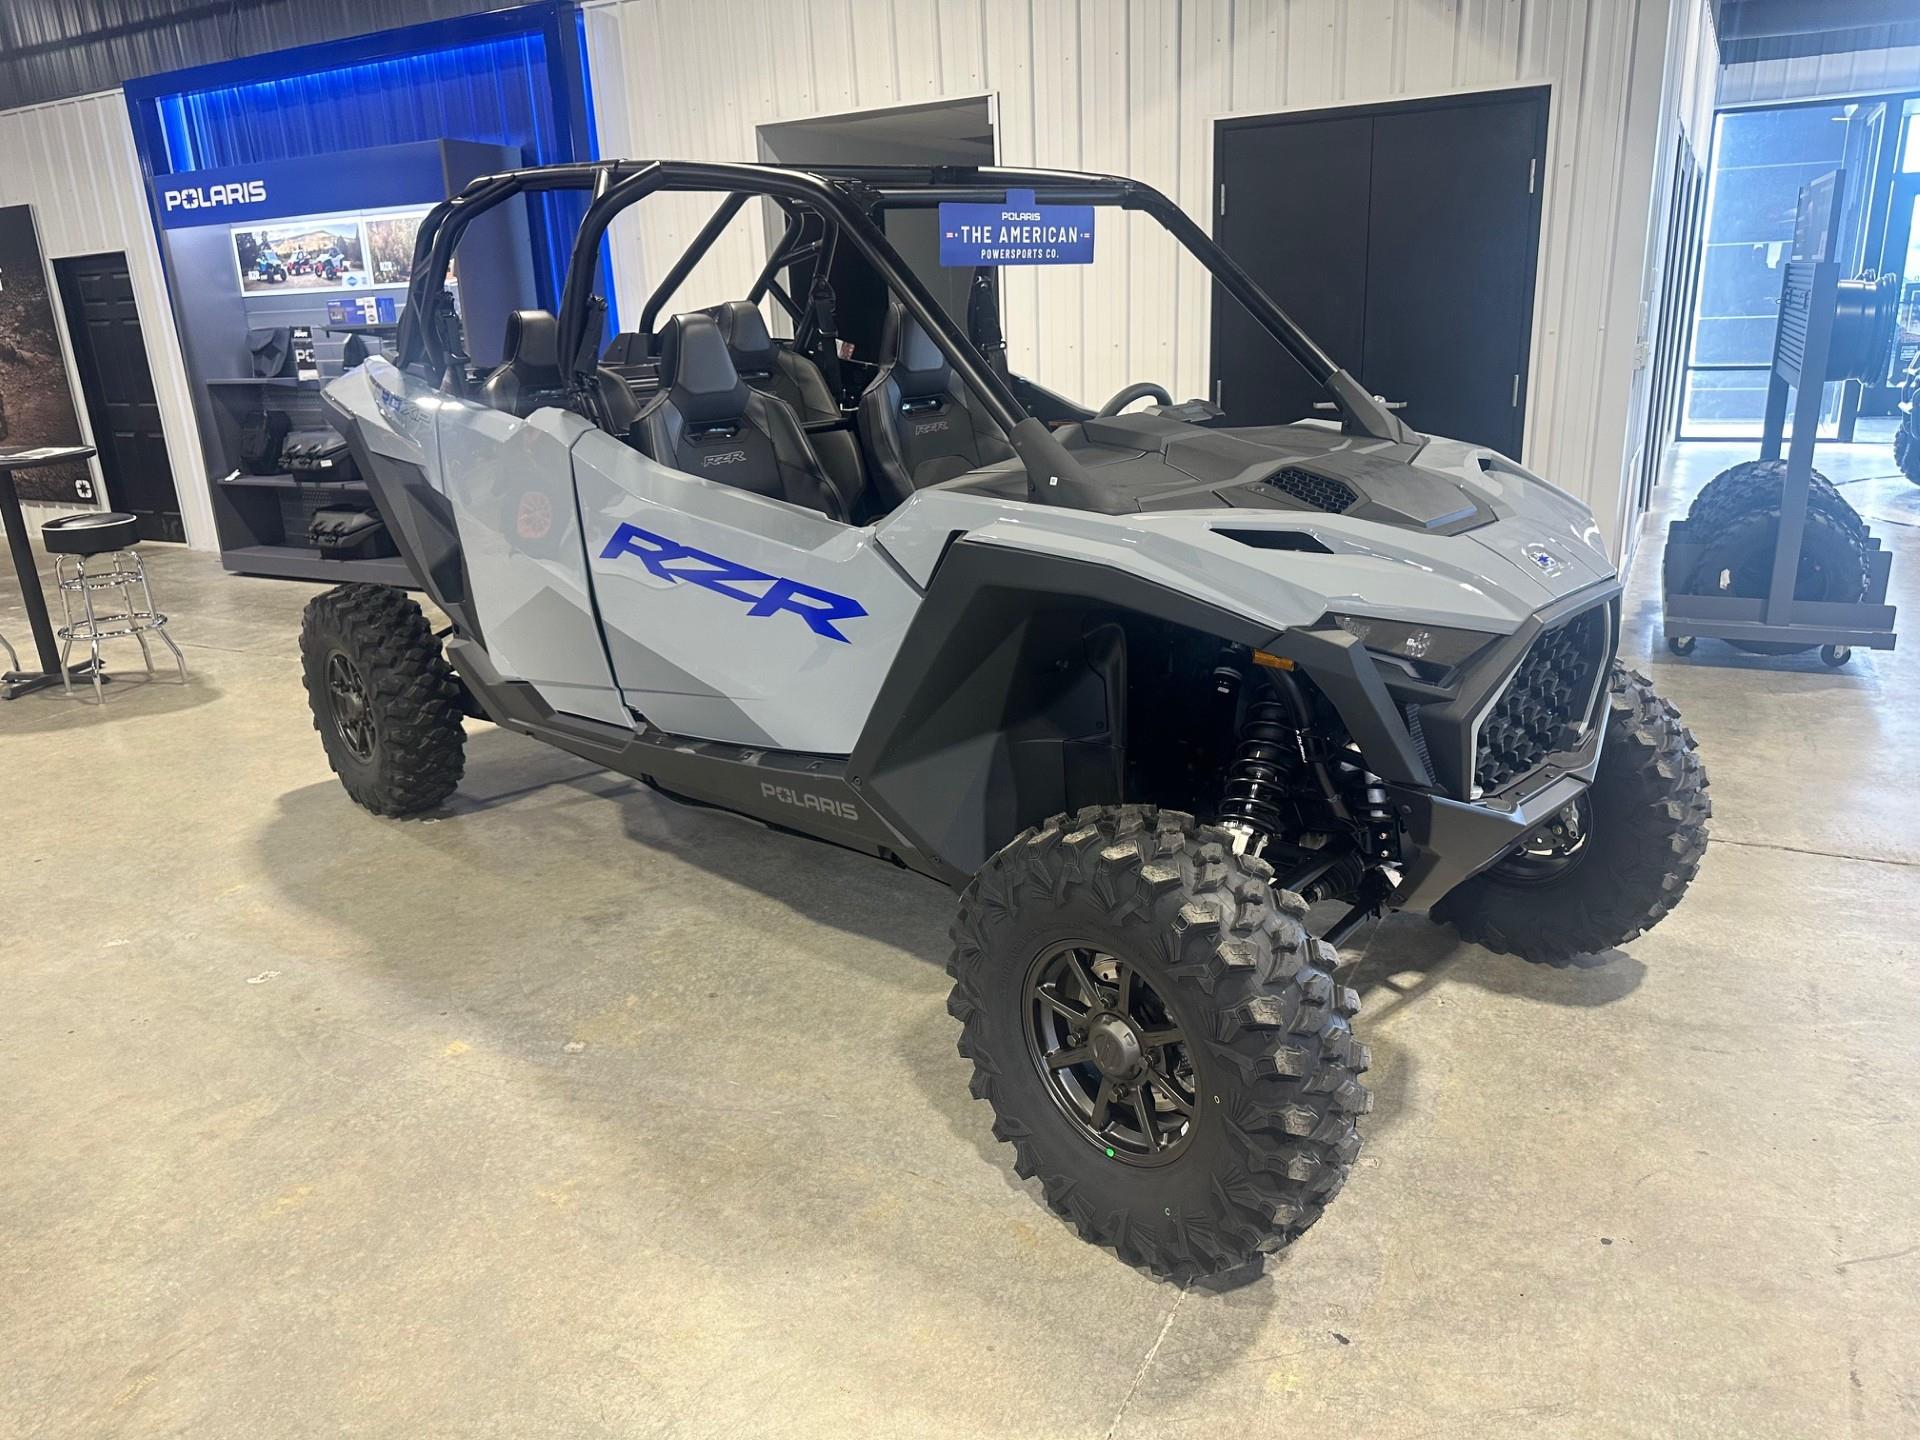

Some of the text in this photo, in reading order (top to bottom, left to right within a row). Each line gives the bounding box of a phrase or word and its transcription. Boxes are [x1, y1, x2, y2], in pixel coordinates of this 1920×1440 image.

[164, 180, 267, 212] POLARIS
[1001, 211, 1041, 221] POLARIS
[961, 225, 1078, 244] THE AMERICAN
[980, 248, 1060, 260] POWERSPORTS CO.
[914, 420, 949, 436] RZR
[703, 449, 748, 468] RZR
[599, 521, 869, 645] RZR
[760, 782, 859, 821] POLARIS
